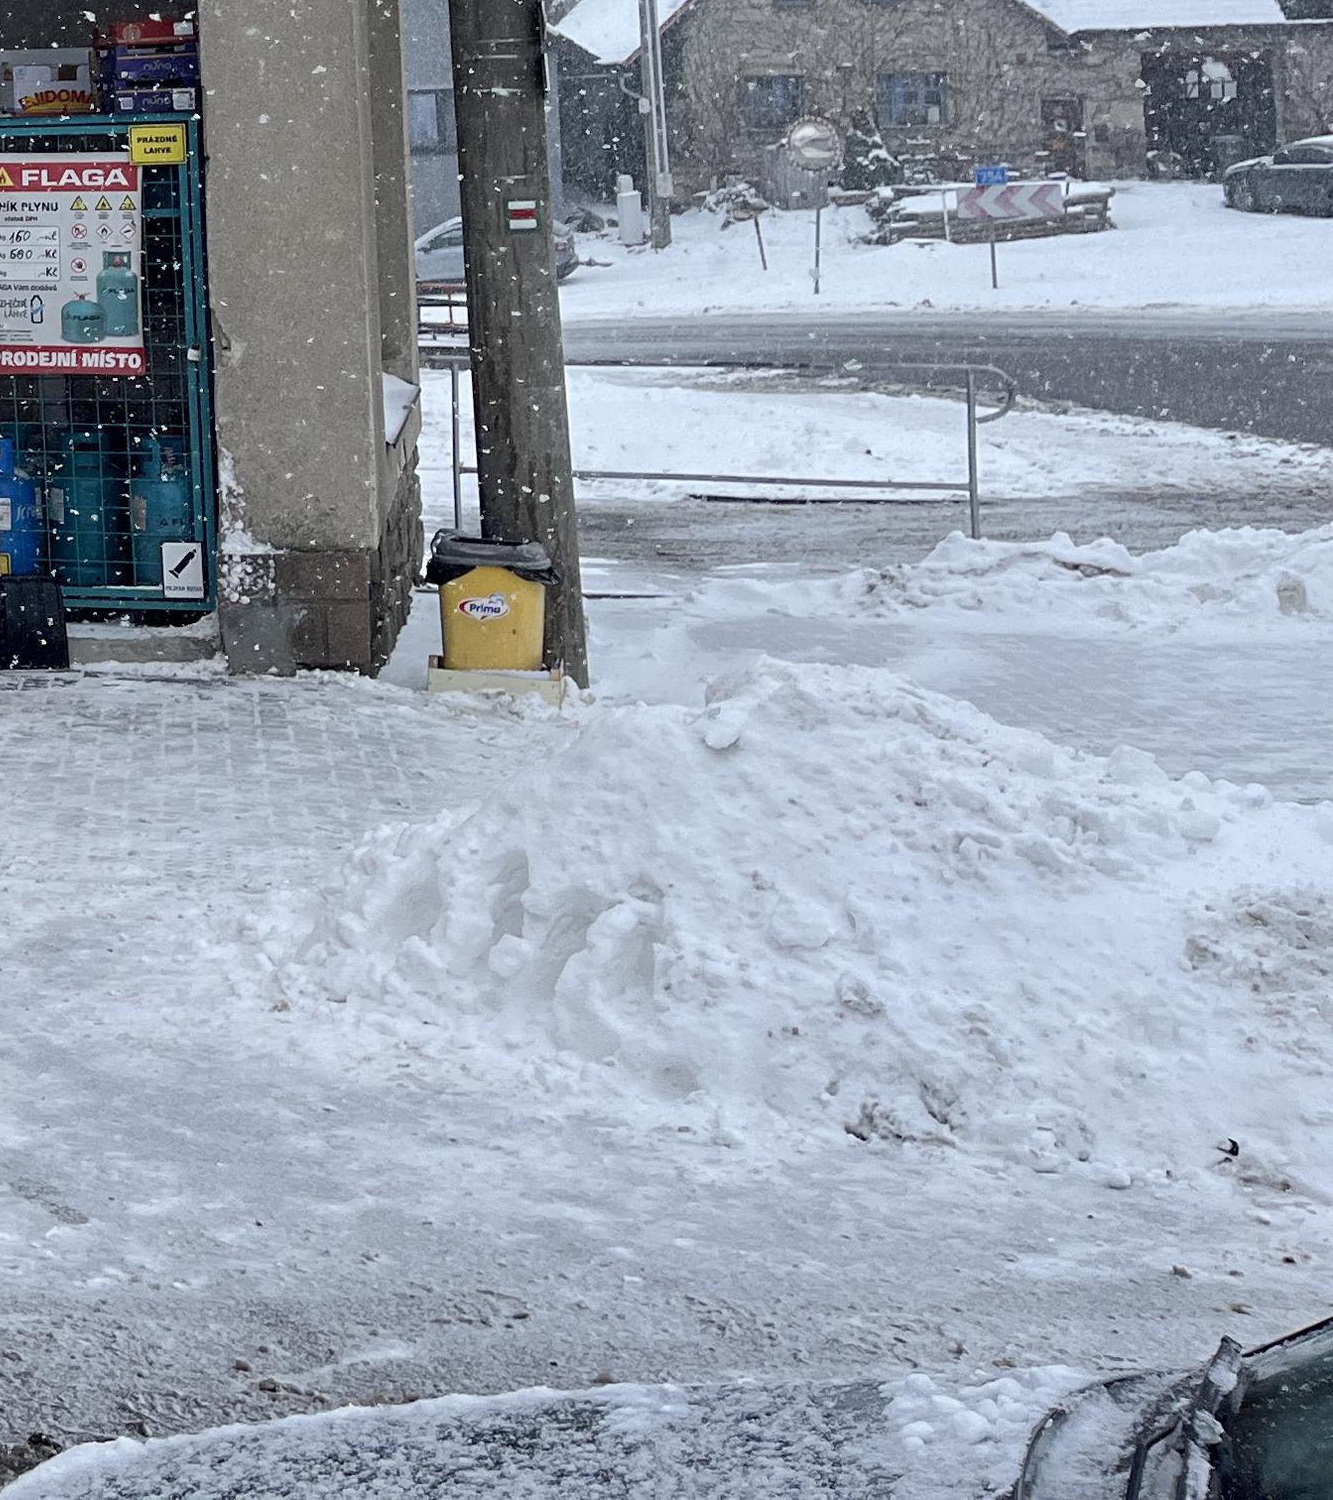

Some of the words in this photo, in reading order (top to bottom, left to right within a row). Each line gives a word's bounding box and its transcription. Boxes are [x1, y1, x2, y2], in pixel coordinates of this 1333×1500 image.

[22, 168, 129, 187] FLAGA
[21, 201, 59, 212] PLYNU
[82, 349, 142, 369] MÍSTO
[470, 603, 501, 614] Prima
